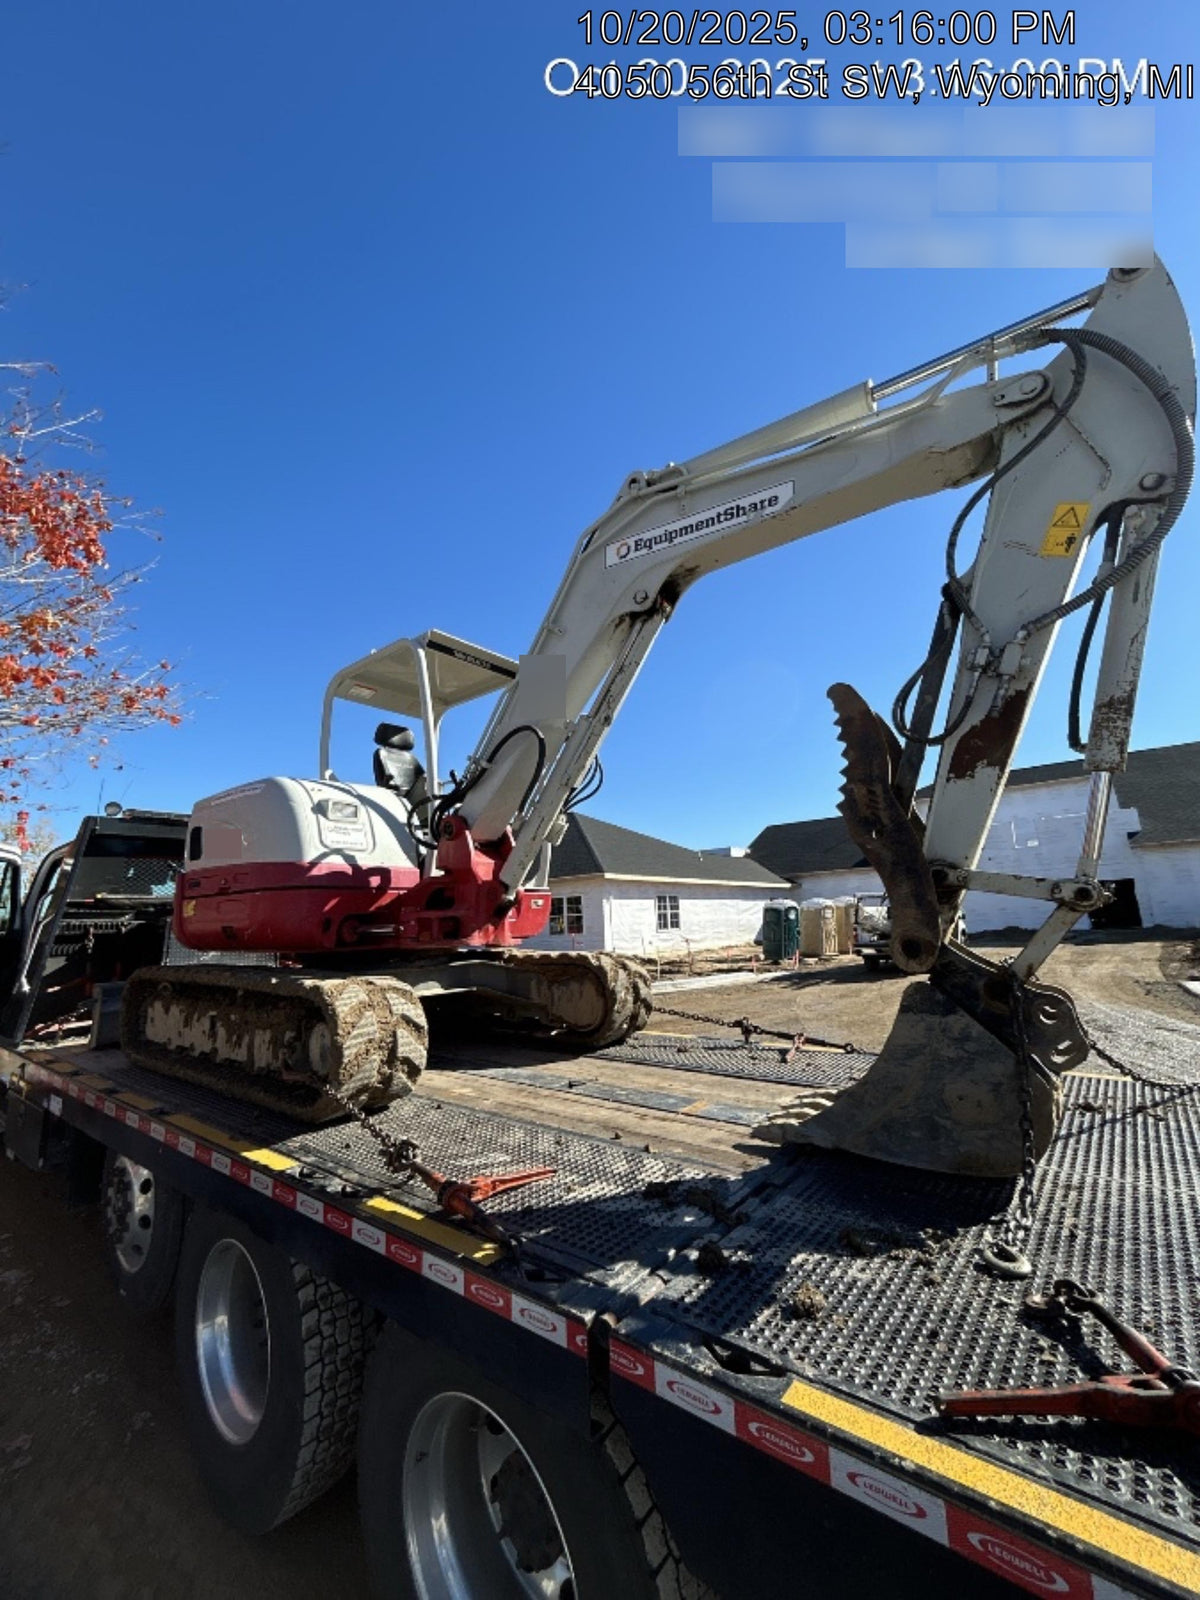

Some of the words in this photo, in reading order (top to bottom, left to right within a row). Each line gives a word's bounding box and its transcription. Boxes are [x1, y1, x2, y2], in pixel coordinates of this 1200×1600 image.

[633, 495, 780, 553] EquipmentShare
[862, 1478, 910, 1510] LEDWELL
[987, 1541, 1049, 1582] LEDWELL
